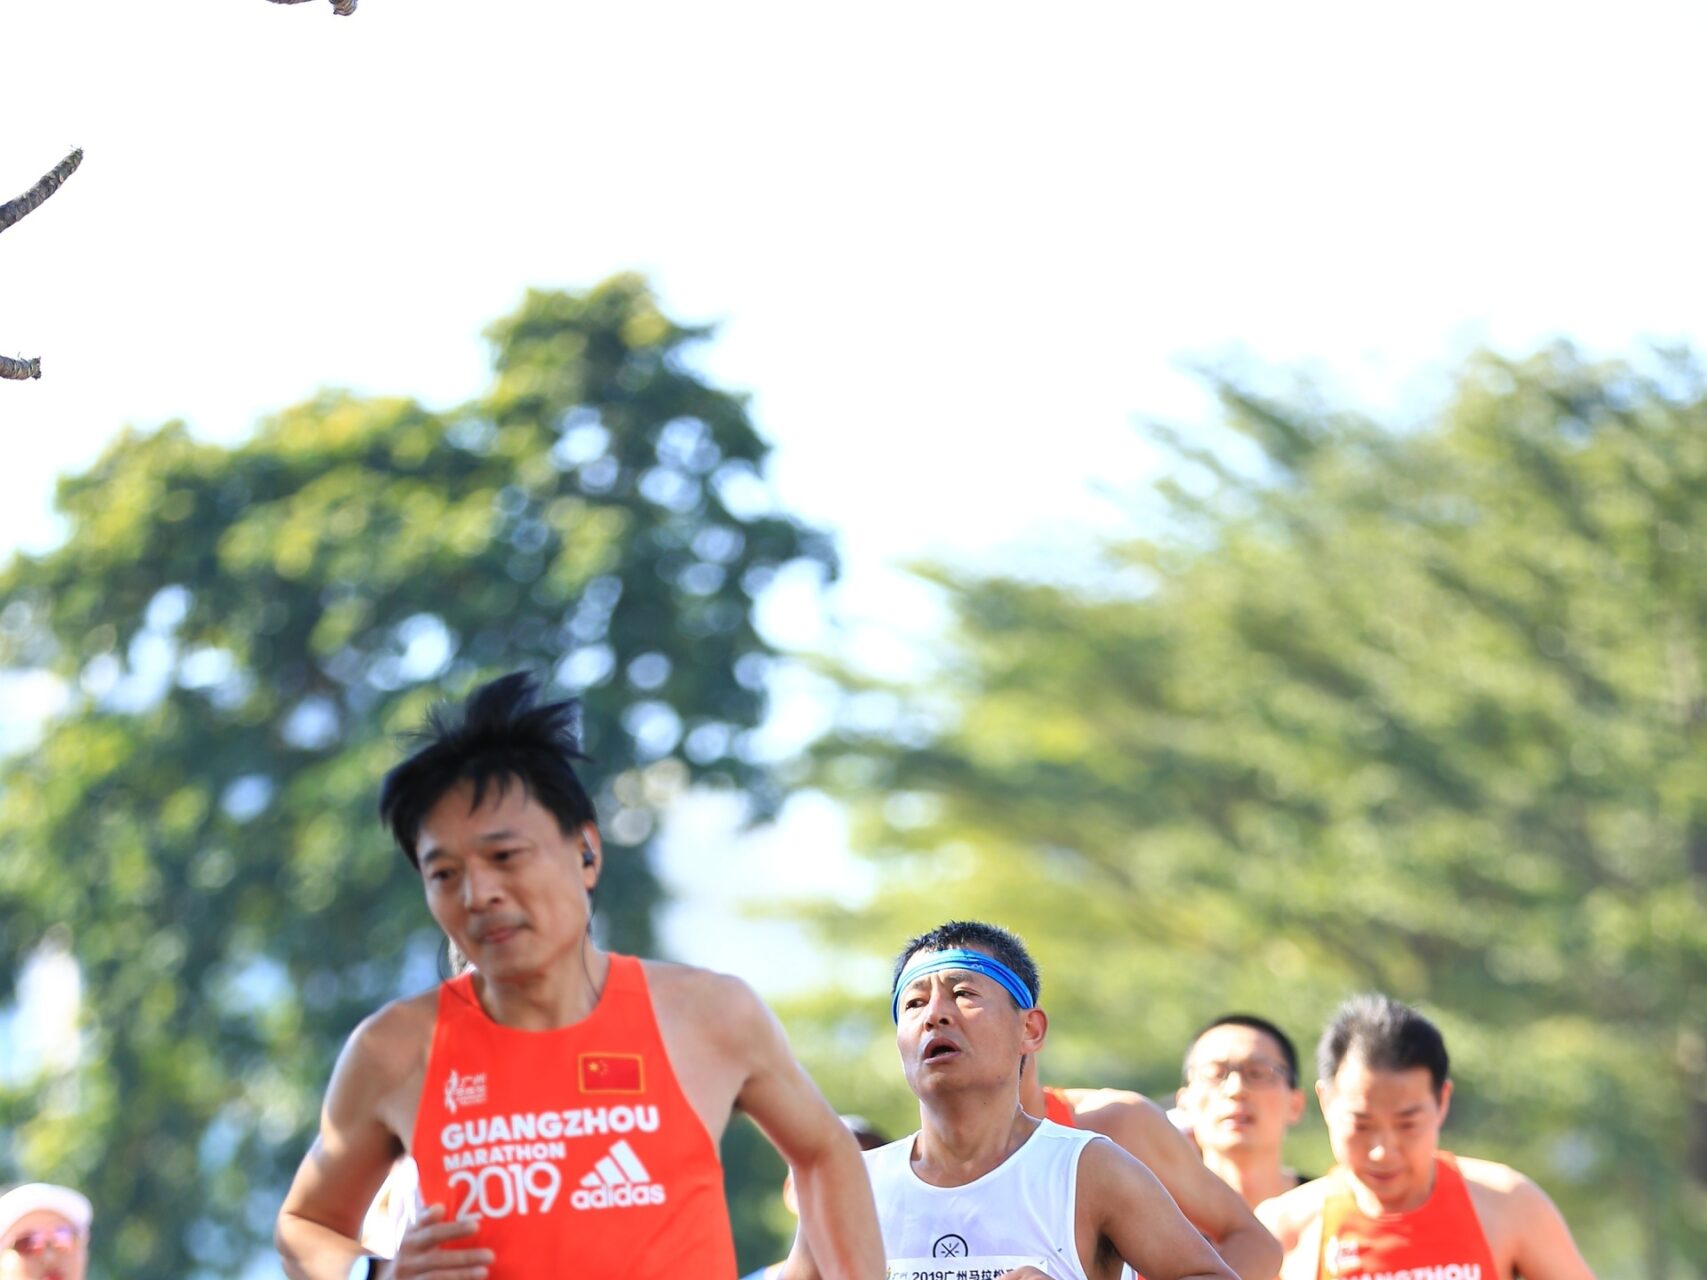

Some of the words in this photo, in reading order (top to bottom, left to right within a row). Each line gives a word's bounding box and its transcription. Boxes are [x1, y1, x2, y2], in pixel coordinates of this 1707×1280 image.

[441, 1105, 660, 1150] GUANGZHOU
[443, 1142, 566, 1171] MARATHON
[448, 1162, 561, 1222] 2019
[570, 1184, 666, 1210] adidas
